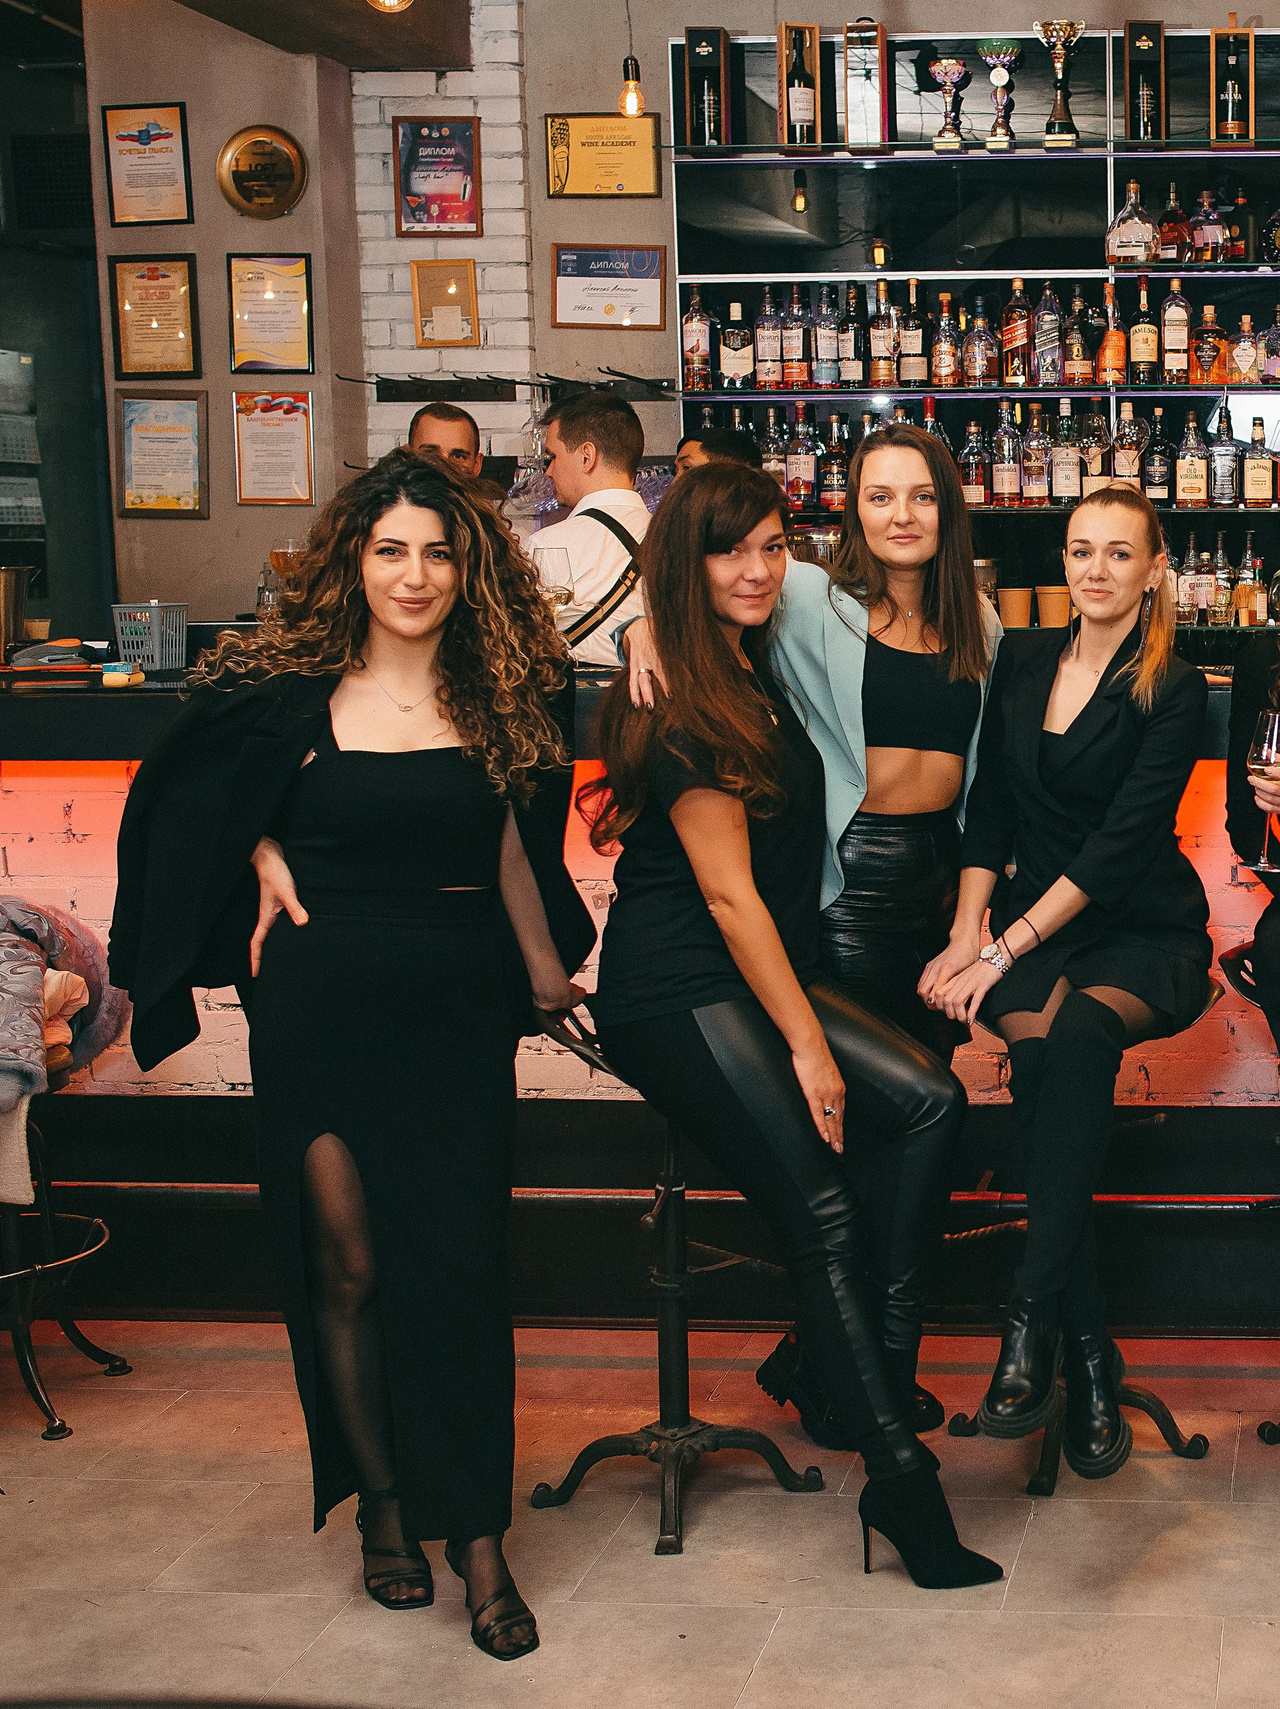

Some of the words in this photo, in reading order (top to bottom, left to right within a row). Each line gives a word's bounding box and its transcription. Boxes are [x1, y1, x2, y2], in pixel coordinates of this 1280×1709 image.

[419, 147, 455, 156] ДИПЛОМ
[248, 163, 276, 172] LOFT
[590, 261, 629, 269] ДИПЛОМ
[1012, 328, 1027, 336] LABEL
[1131, 327, 1157, 335] JAMESON
[1257, 463, 1271, 472] DANIEL'S
